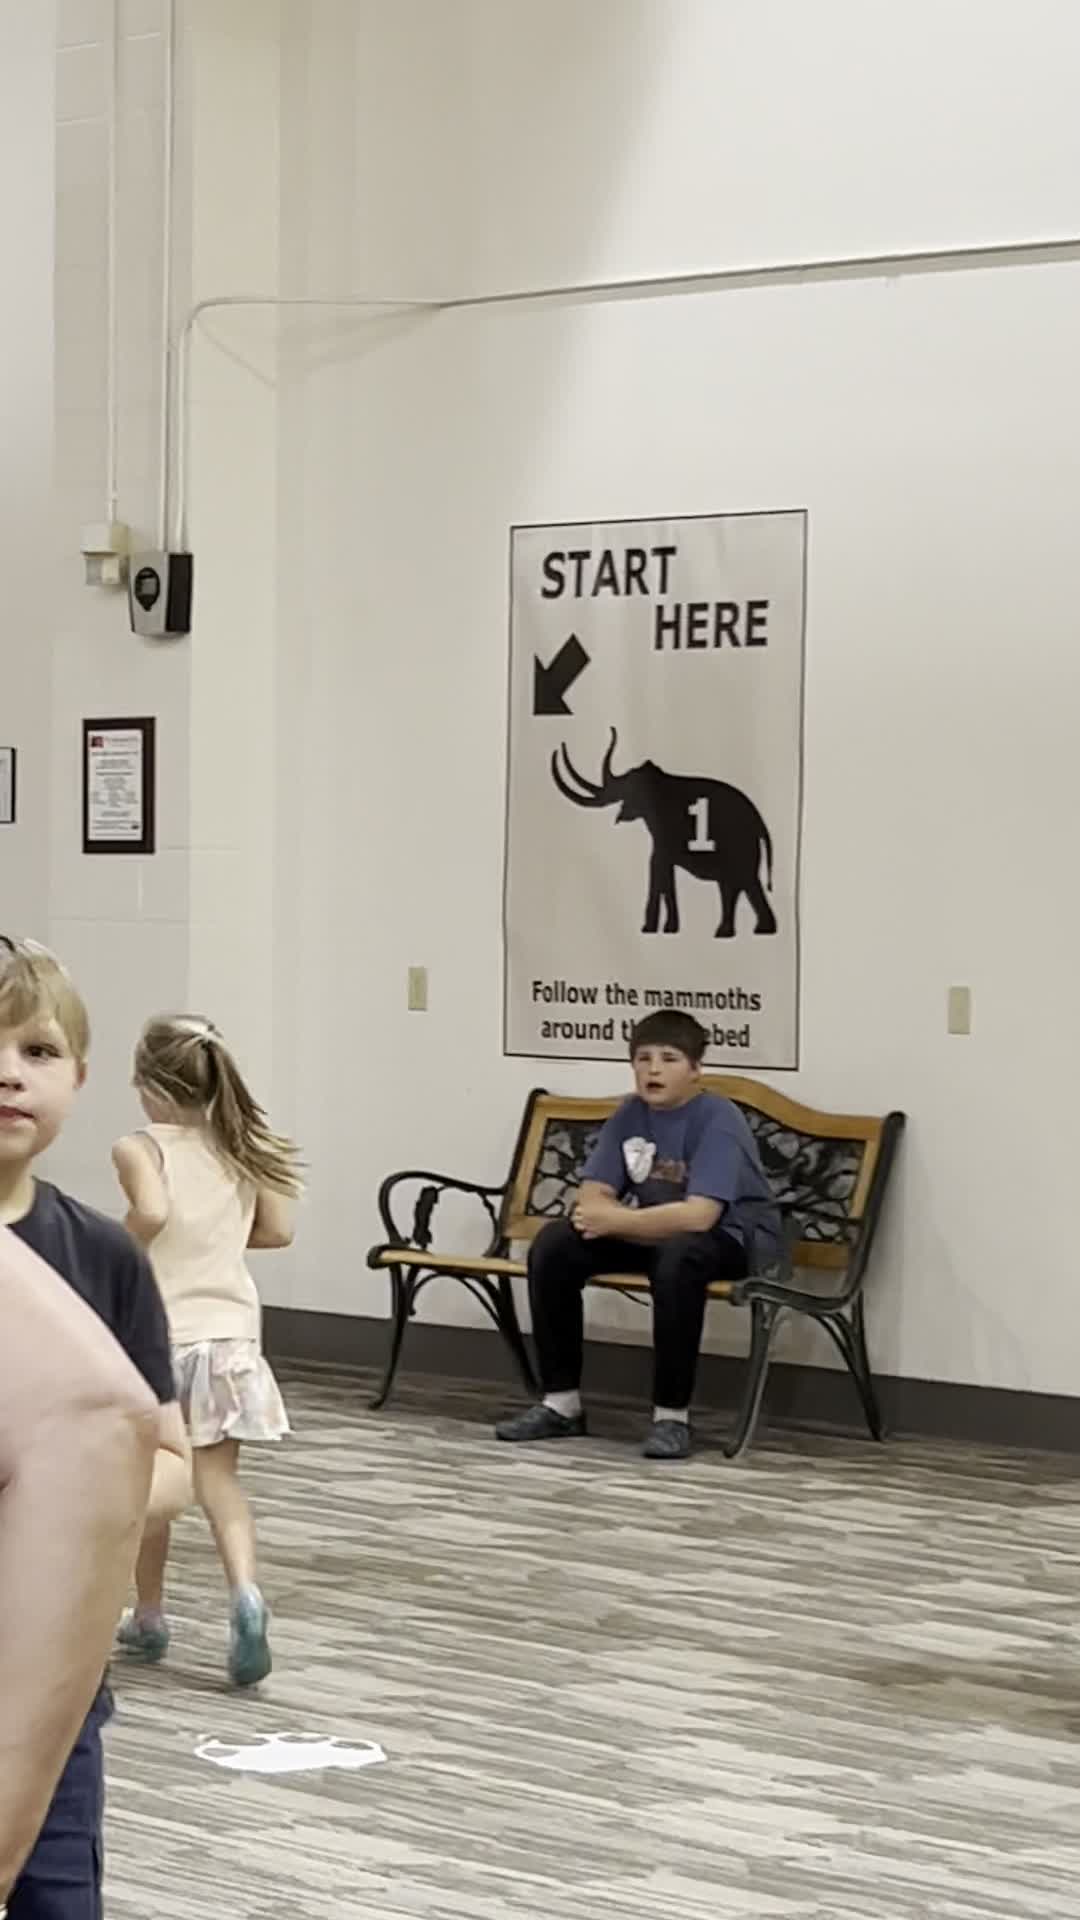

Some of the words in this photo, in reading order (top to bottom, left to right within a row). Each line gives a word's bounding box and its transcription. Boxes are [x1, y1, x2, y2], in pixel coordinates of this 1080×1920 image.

[541, 546, 677, 599] START
[654, 600, 769, 650] HERE
[687, 797, 716, 852] 1
[532, 980, 598, 1004] Follow
[605, 982, 639, 1006] the
[644, 987, 761, 1011] mammoths
[541, 1018, 614, 1041] around
[622, 1018, 640, 1042] th
